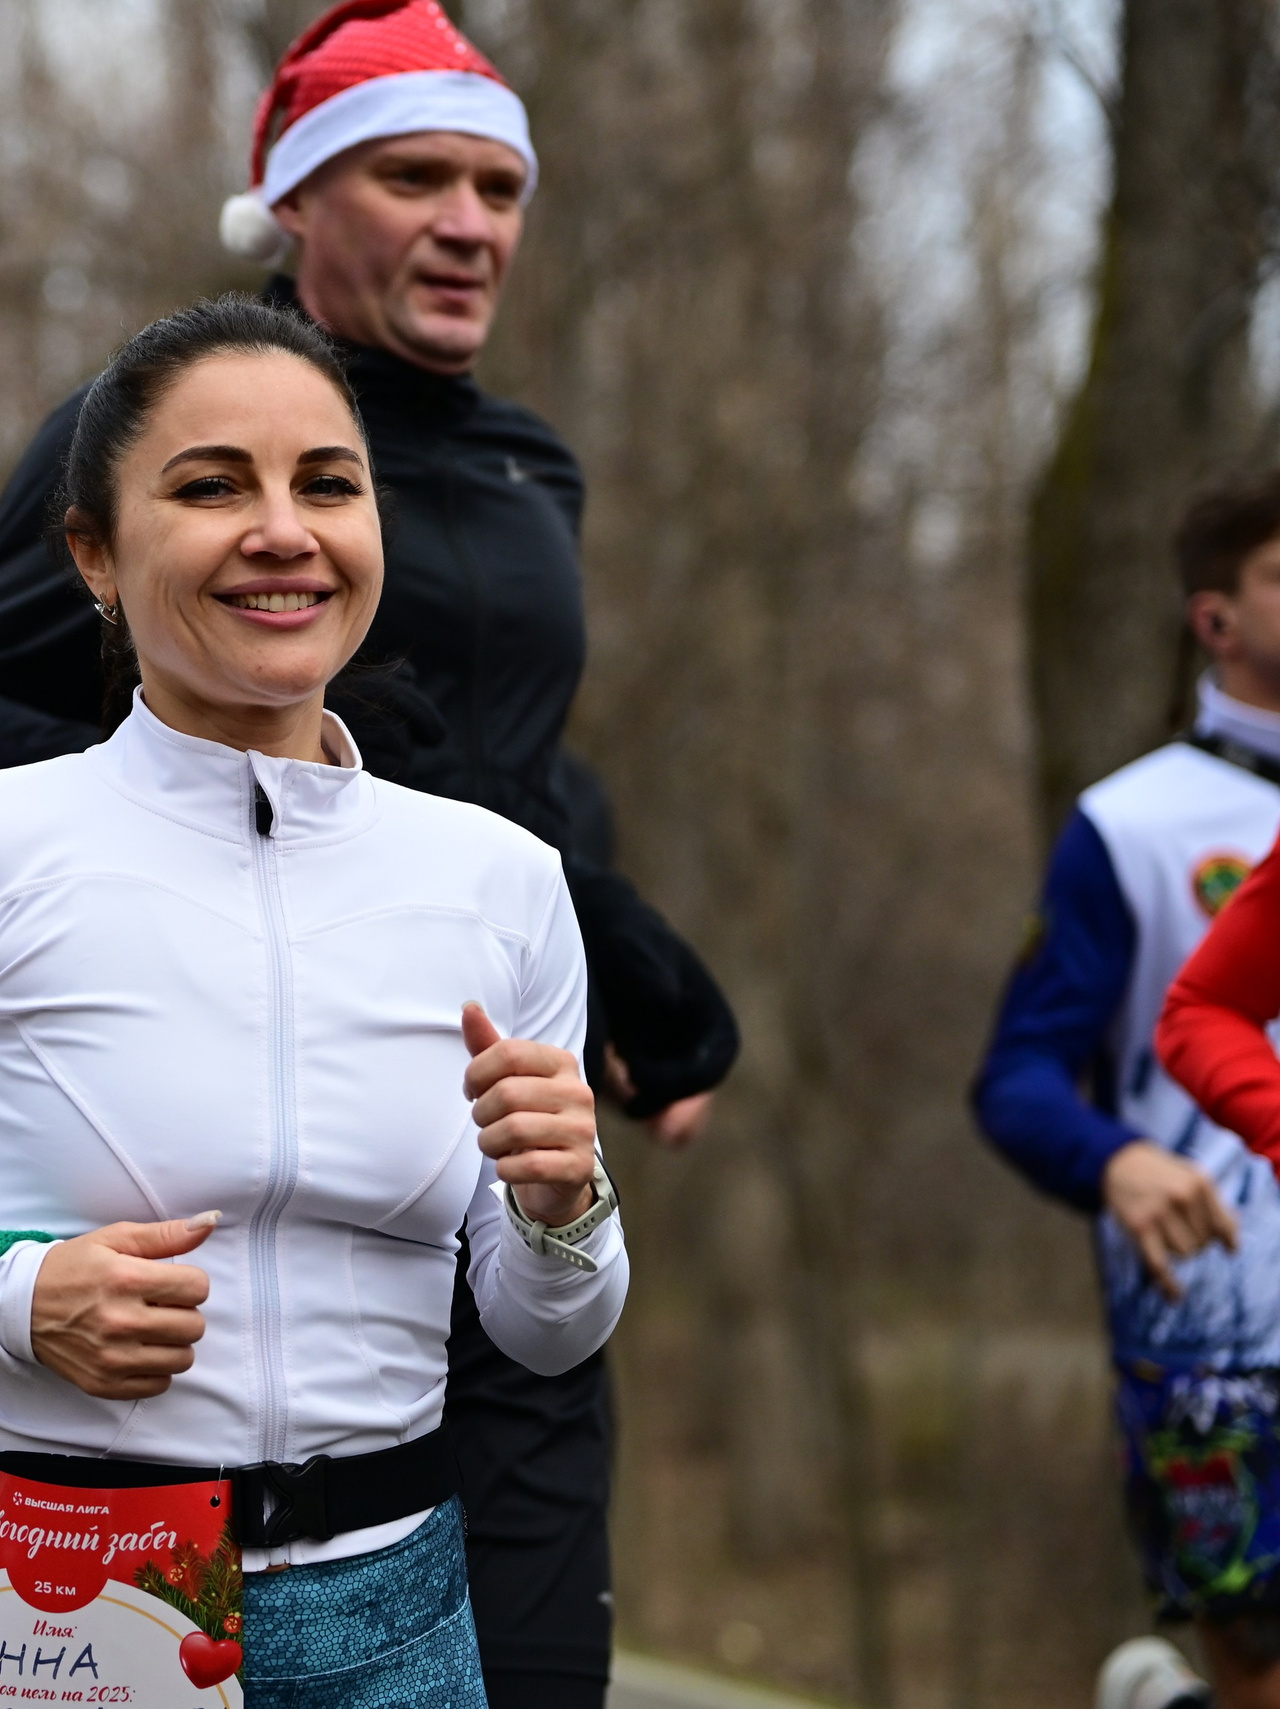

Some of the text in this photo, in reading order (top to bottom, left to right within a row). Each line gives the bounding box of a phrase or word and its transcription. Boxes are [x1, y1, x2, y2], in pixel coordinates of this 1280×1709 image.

[24, 1497, 110, 1515] ВЫСШАЯ ЛИГА
[102, 1521, 178, 1566] забег
[34, 1580, 52, 1595] 25
[32, 1619, 78, 1639] Имя:
[20, 1687, 57, 1701] цель
[61, 1690, 83, 1702] на
[86, 1686, 136, 1703] 2025:
